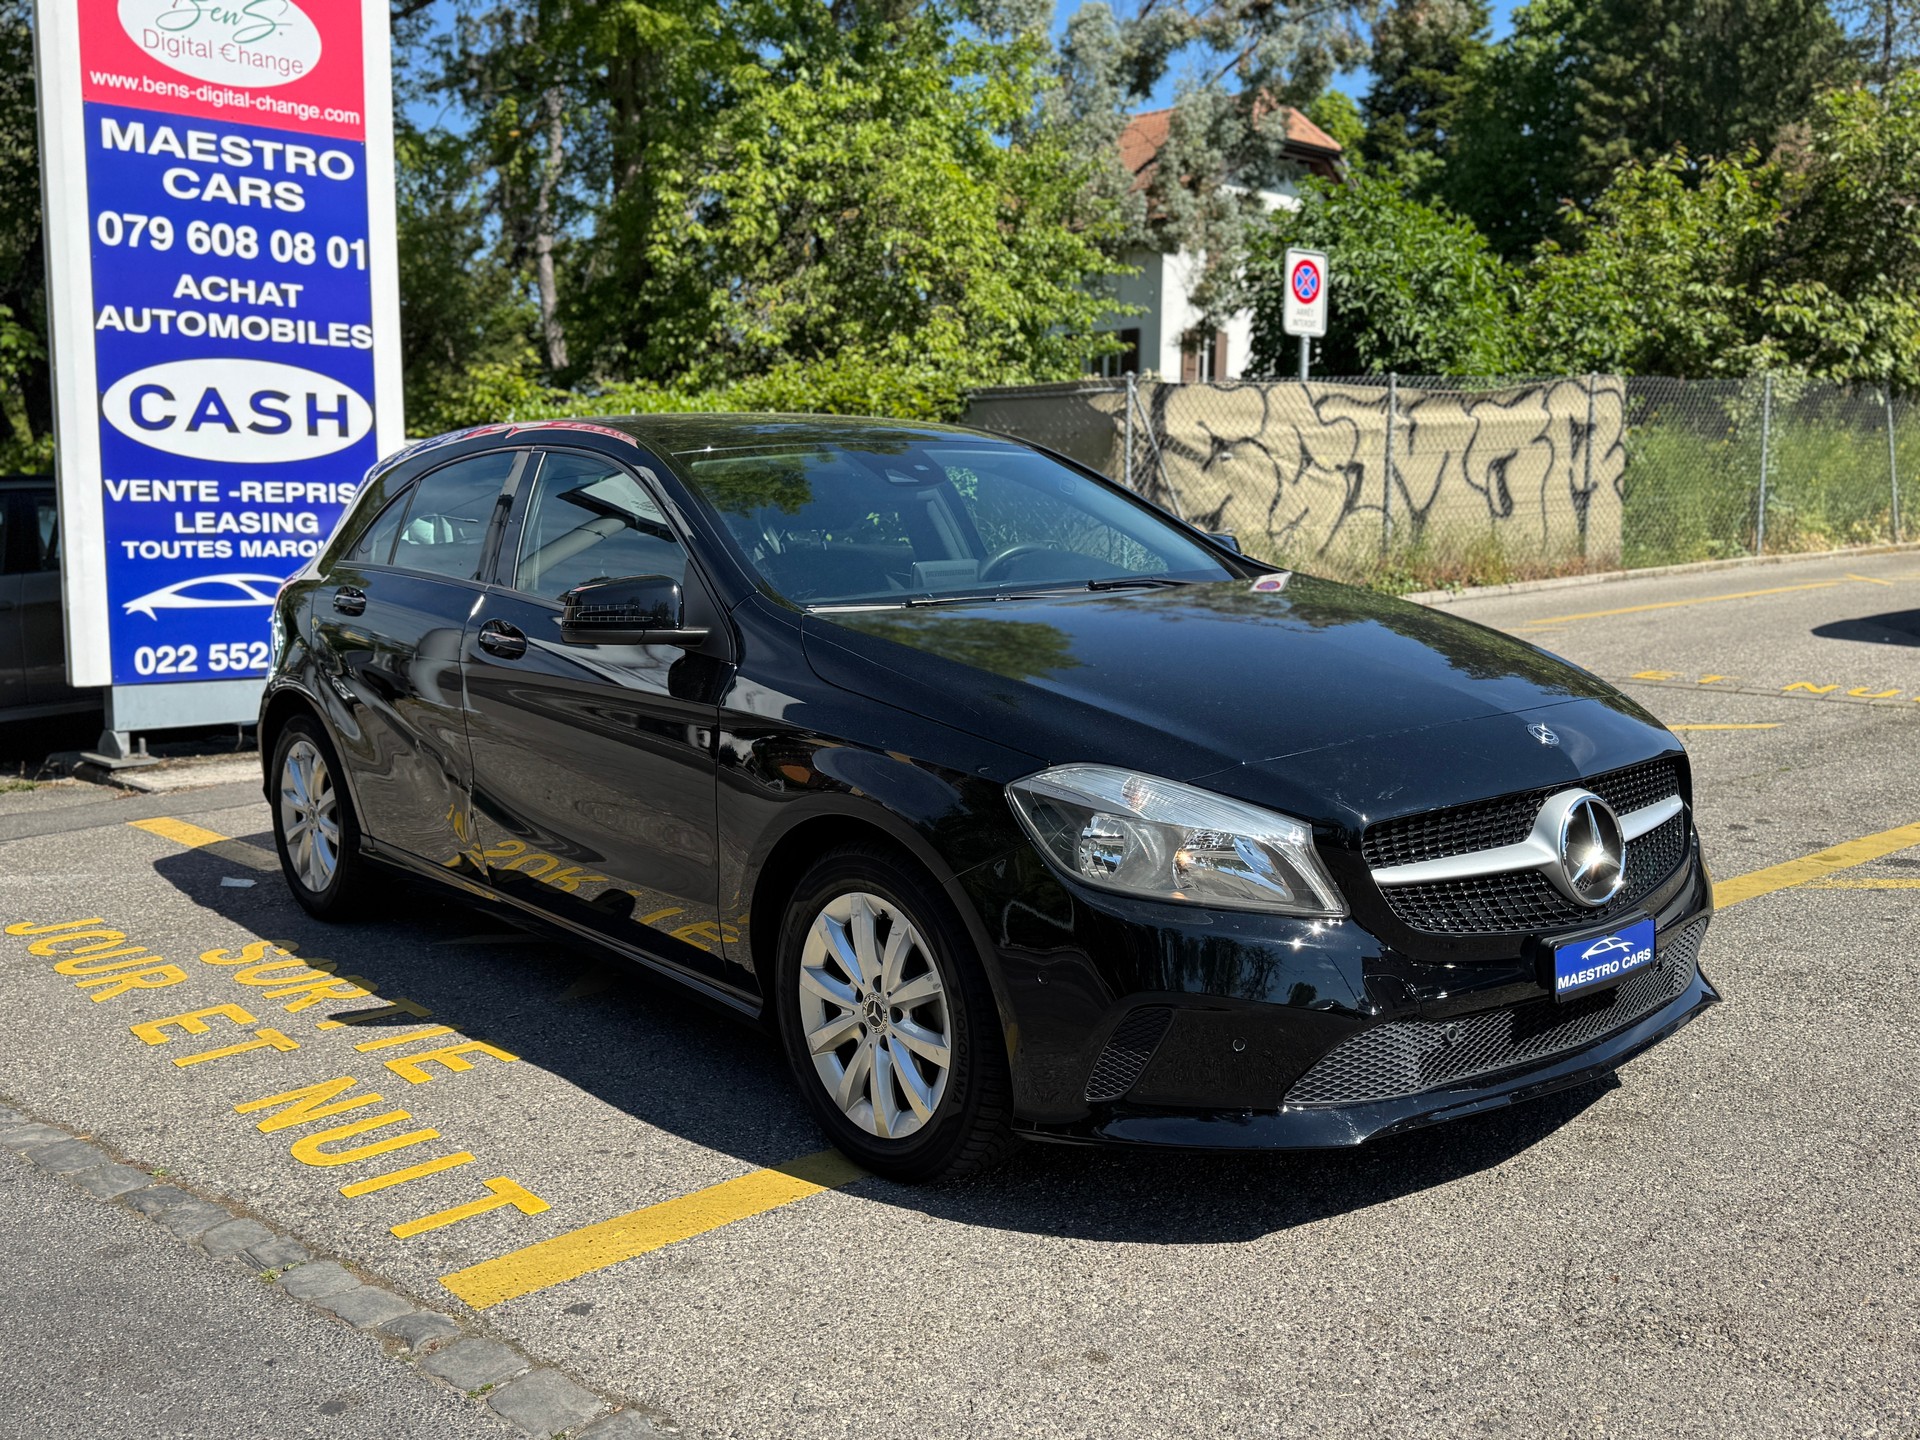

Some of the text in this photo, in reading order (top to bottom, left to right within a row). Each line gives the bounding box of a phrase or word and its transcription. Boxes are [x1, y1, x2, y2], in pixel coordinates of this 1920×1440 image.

[143, 28, 214, 59] Digital
[90, 70, 361, 125] www.bens-digital-change.com
[100, 117, 355, 182] MAESTRO
[162, 167, 306, 213] CARS
[97, 210, 366, 271] 079 608 08 01
[173, 273, 304, 308] ACHAT
[95, 305, 373, 350] AUTOMOBILES
[128, 383, 350, 438] CASH
[104, 479, 220, 503] VENTE
[174, 511, 320, 535] LEASING
[121, 540, 326, 560] TOUTES MARQ
[134, 641, 269, 676] 022 552
[1557, 947, 1652, 990] MAESTRO CARS
[199, 939, 520, 1084] SORTIE
[4, 916, 551, 1240] JOUR ET NUIT
[952, 1005, 973, 1106] YOKOHAMA
